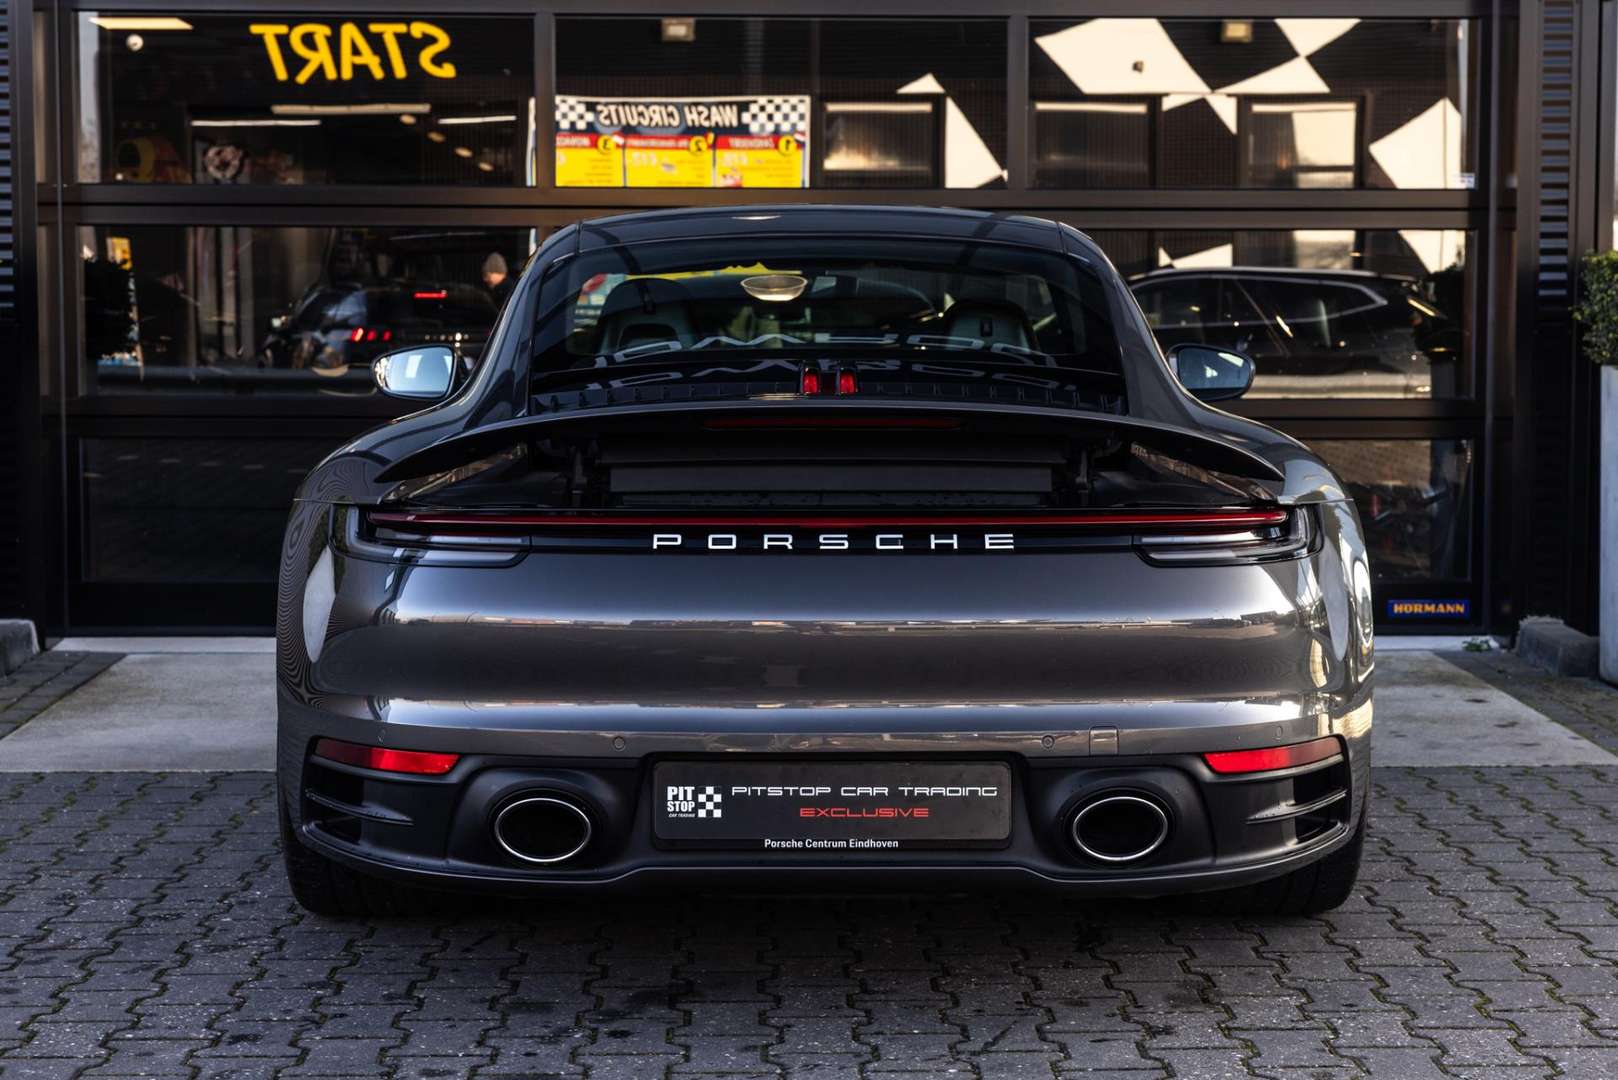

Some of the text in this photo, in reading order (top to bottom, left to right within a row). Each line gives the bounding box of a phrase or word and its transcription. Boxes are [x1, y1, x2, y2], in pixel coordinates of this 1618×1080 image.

[652, 533, 1014, 550] PORSCHE
[667, 786, 695, 801] PIT
[732, 786, 998, 796] PITSTOP CAR TRADING
[667, 801, 695, 812] STOP
[800, 807, 929, 817] EXCLUSIVE
[764, 838, 899, 849] Porsche Centrum Eindhoven
